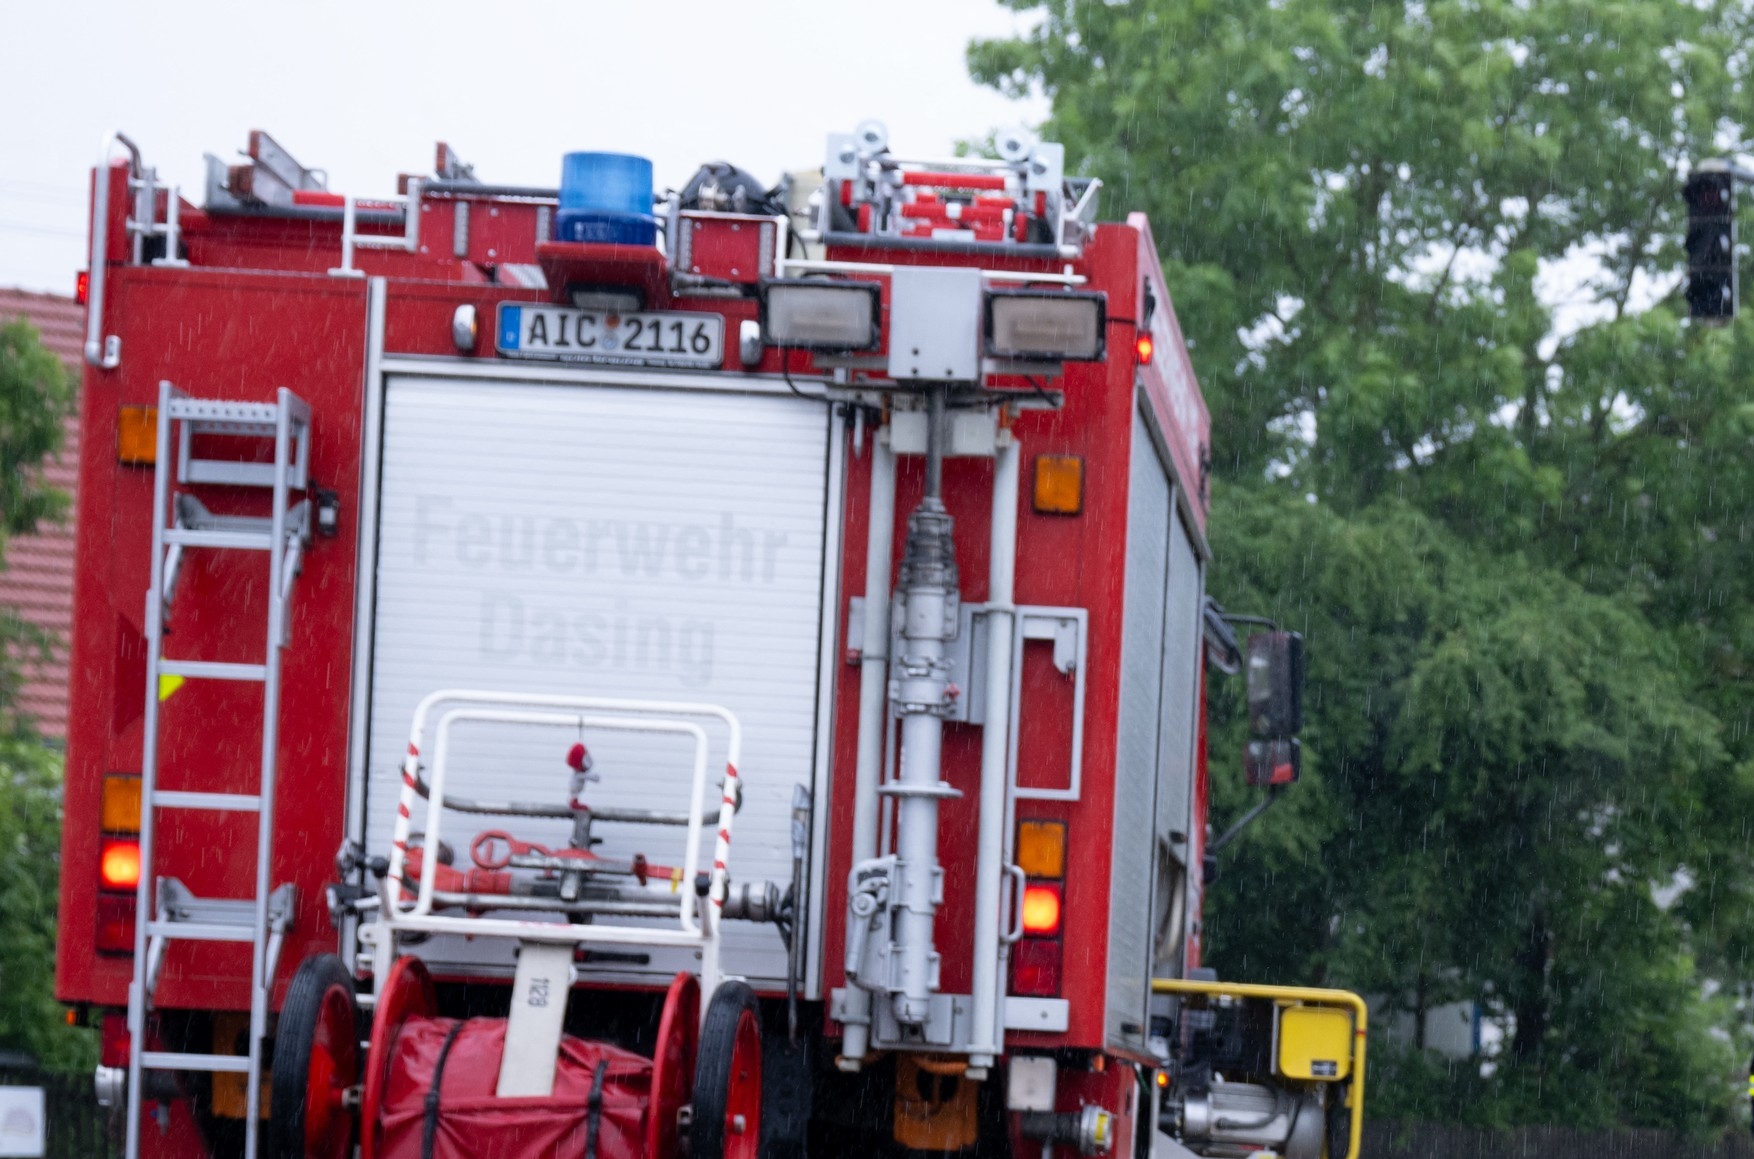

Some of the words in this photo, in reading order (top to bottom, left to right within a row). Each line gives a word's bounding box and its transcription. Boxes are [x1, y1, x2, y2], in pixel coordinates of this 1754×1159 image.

[528, 313, 597, 348] AIC
[624, 317, 711, 355] 2116
[413, 494, 788, 584] Feuerwehr
[478, 589, 714, 688] Dasing
